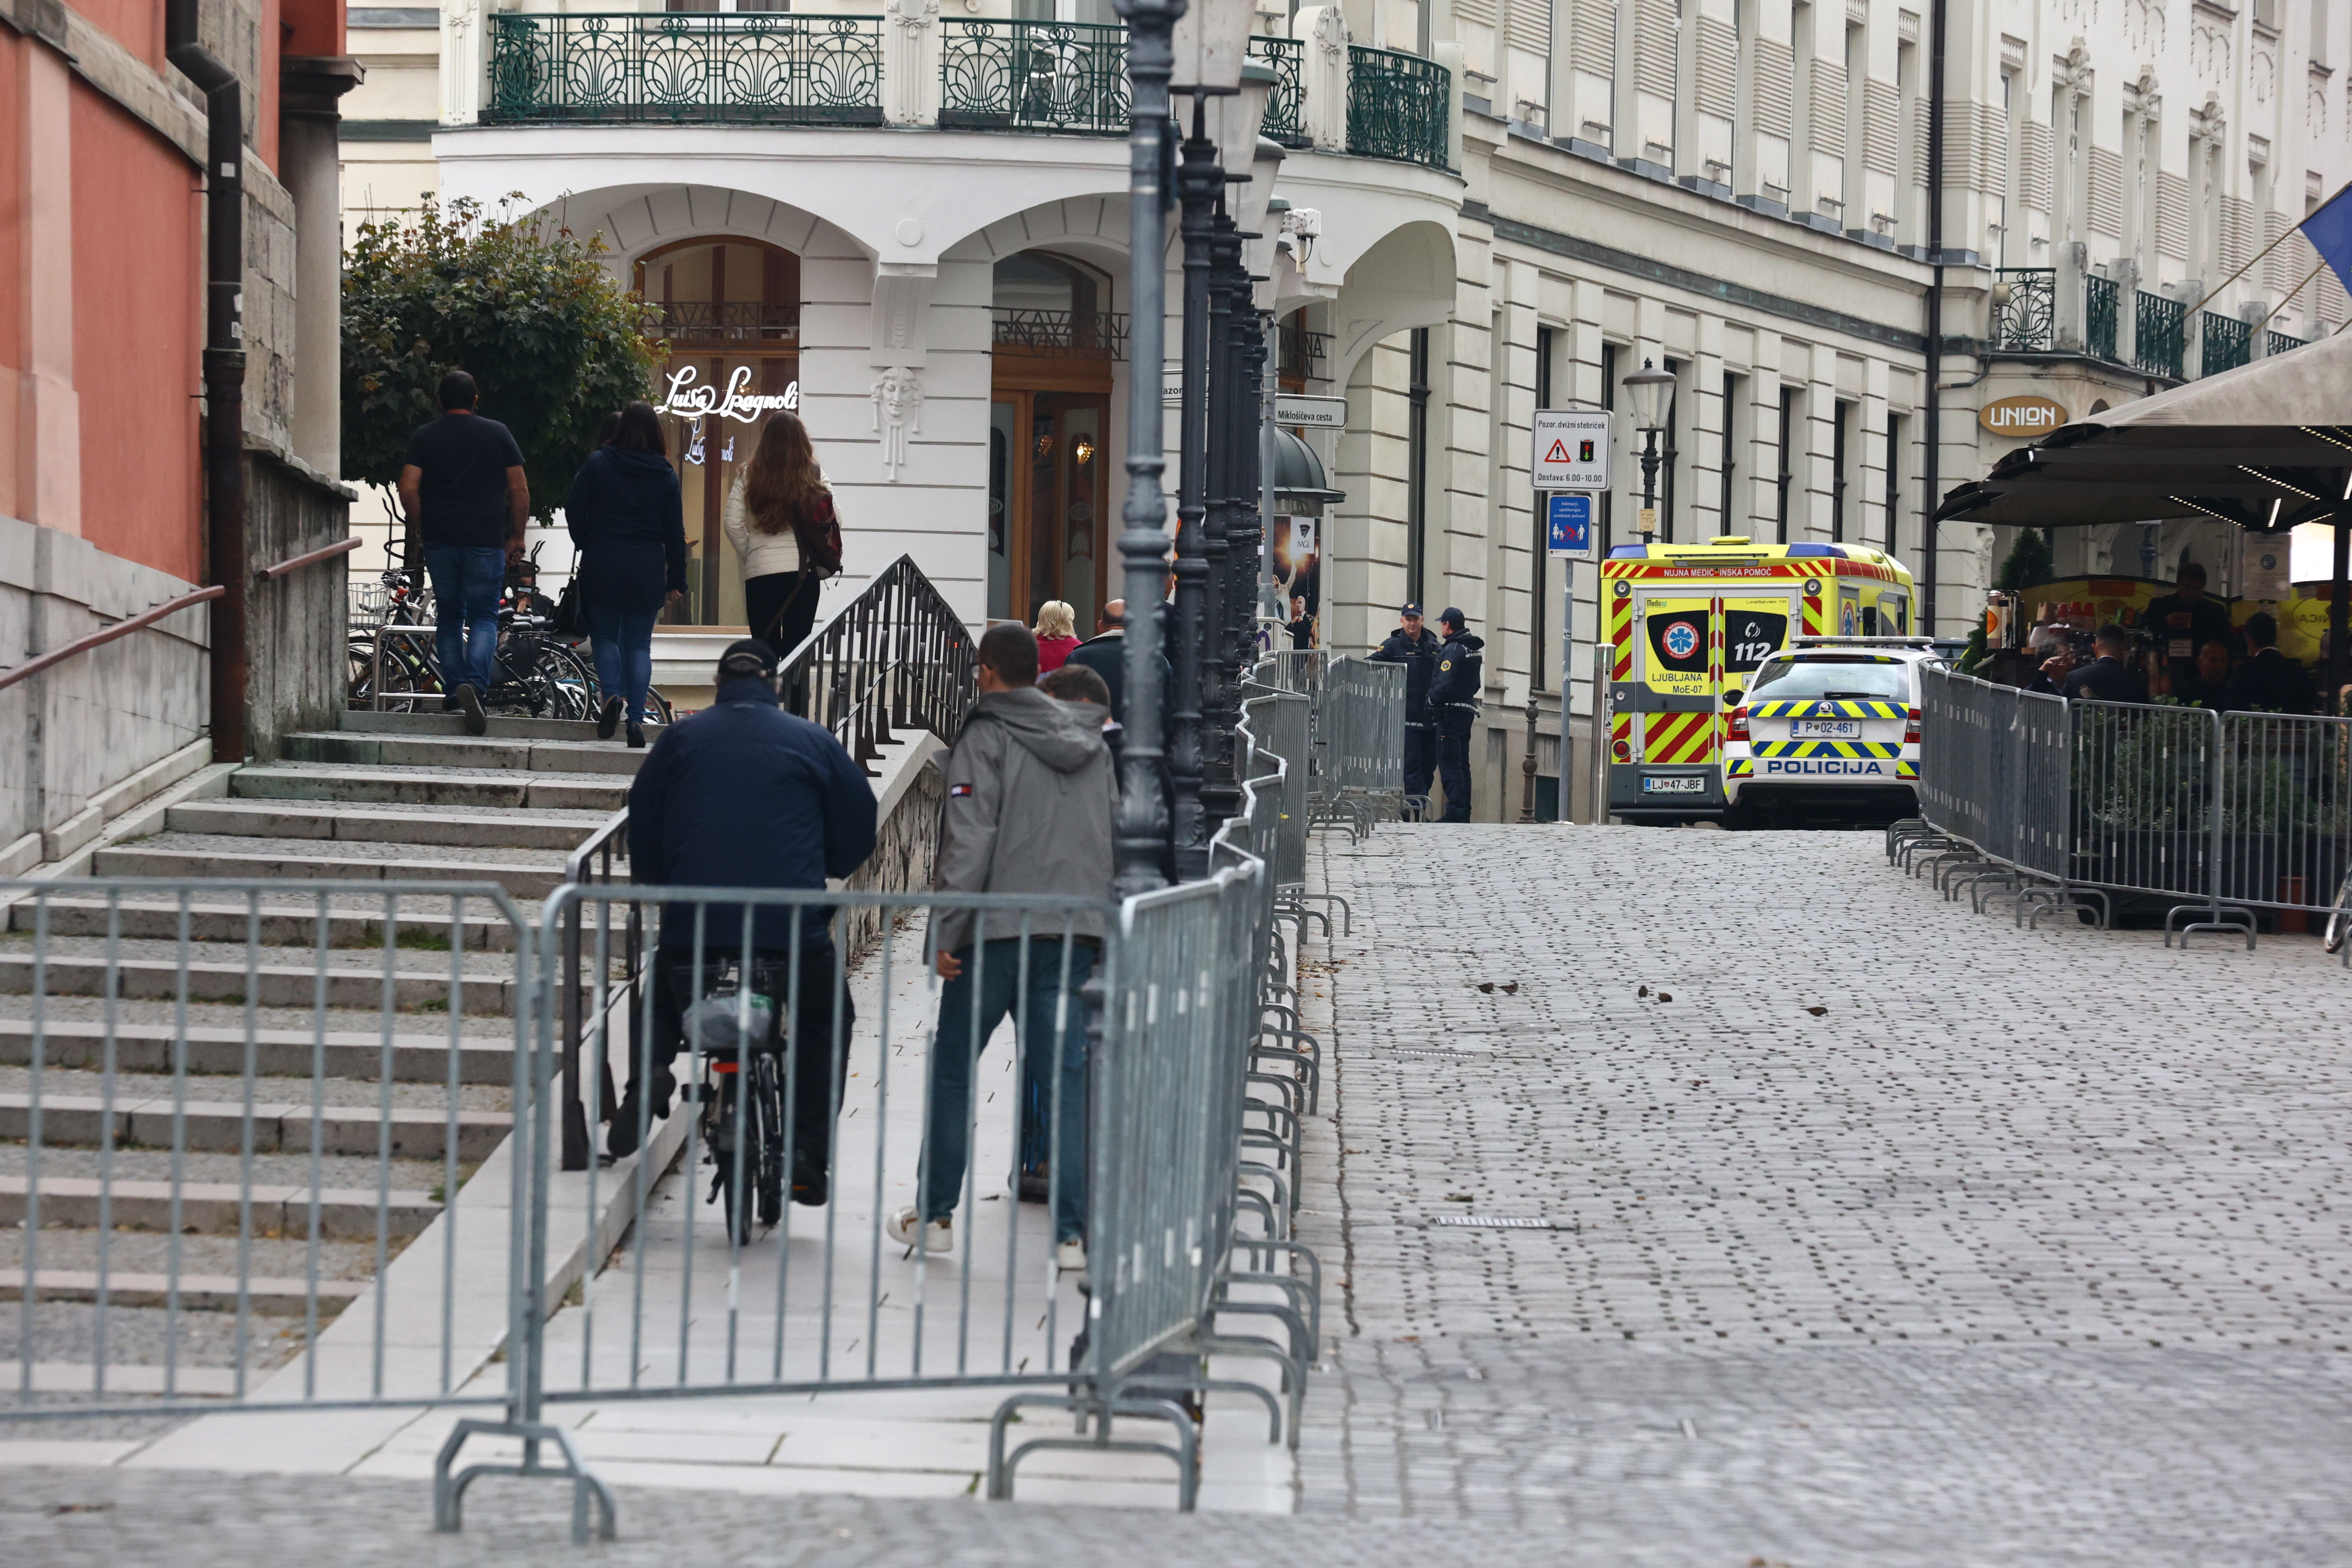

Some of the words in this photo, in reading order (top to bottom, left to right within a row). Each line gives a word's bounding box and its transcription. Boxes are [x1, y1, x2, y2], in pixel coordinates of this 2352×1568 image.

[654, 365, 716, 417] Luisa
[720, 366, 799, 423] Spagnoli
[1278, 410, 1315, 420] Miklošičeva
[1990, 407, 2055, 426] UNION
[1538, 420, 1557, 429] Pozor,
[1664, 569, 1689, 577] NUJNA
[1744, 567, 1772, 576] POMOČ
[1734, 642, 1771, 661] 112
[1652, 673, 1703, 682] LJUBLJANA
[1672, 685, 1703, 693] MoE-07
[1806, 722, 1813, 732] P
[1821, 722, 1853, 733] 02-461
[1767, 761, 1883, 774] POLICIJA
[1652, 780, 1663, 790] LJ
[1670, 780, 1701, 790] 47-JBF
